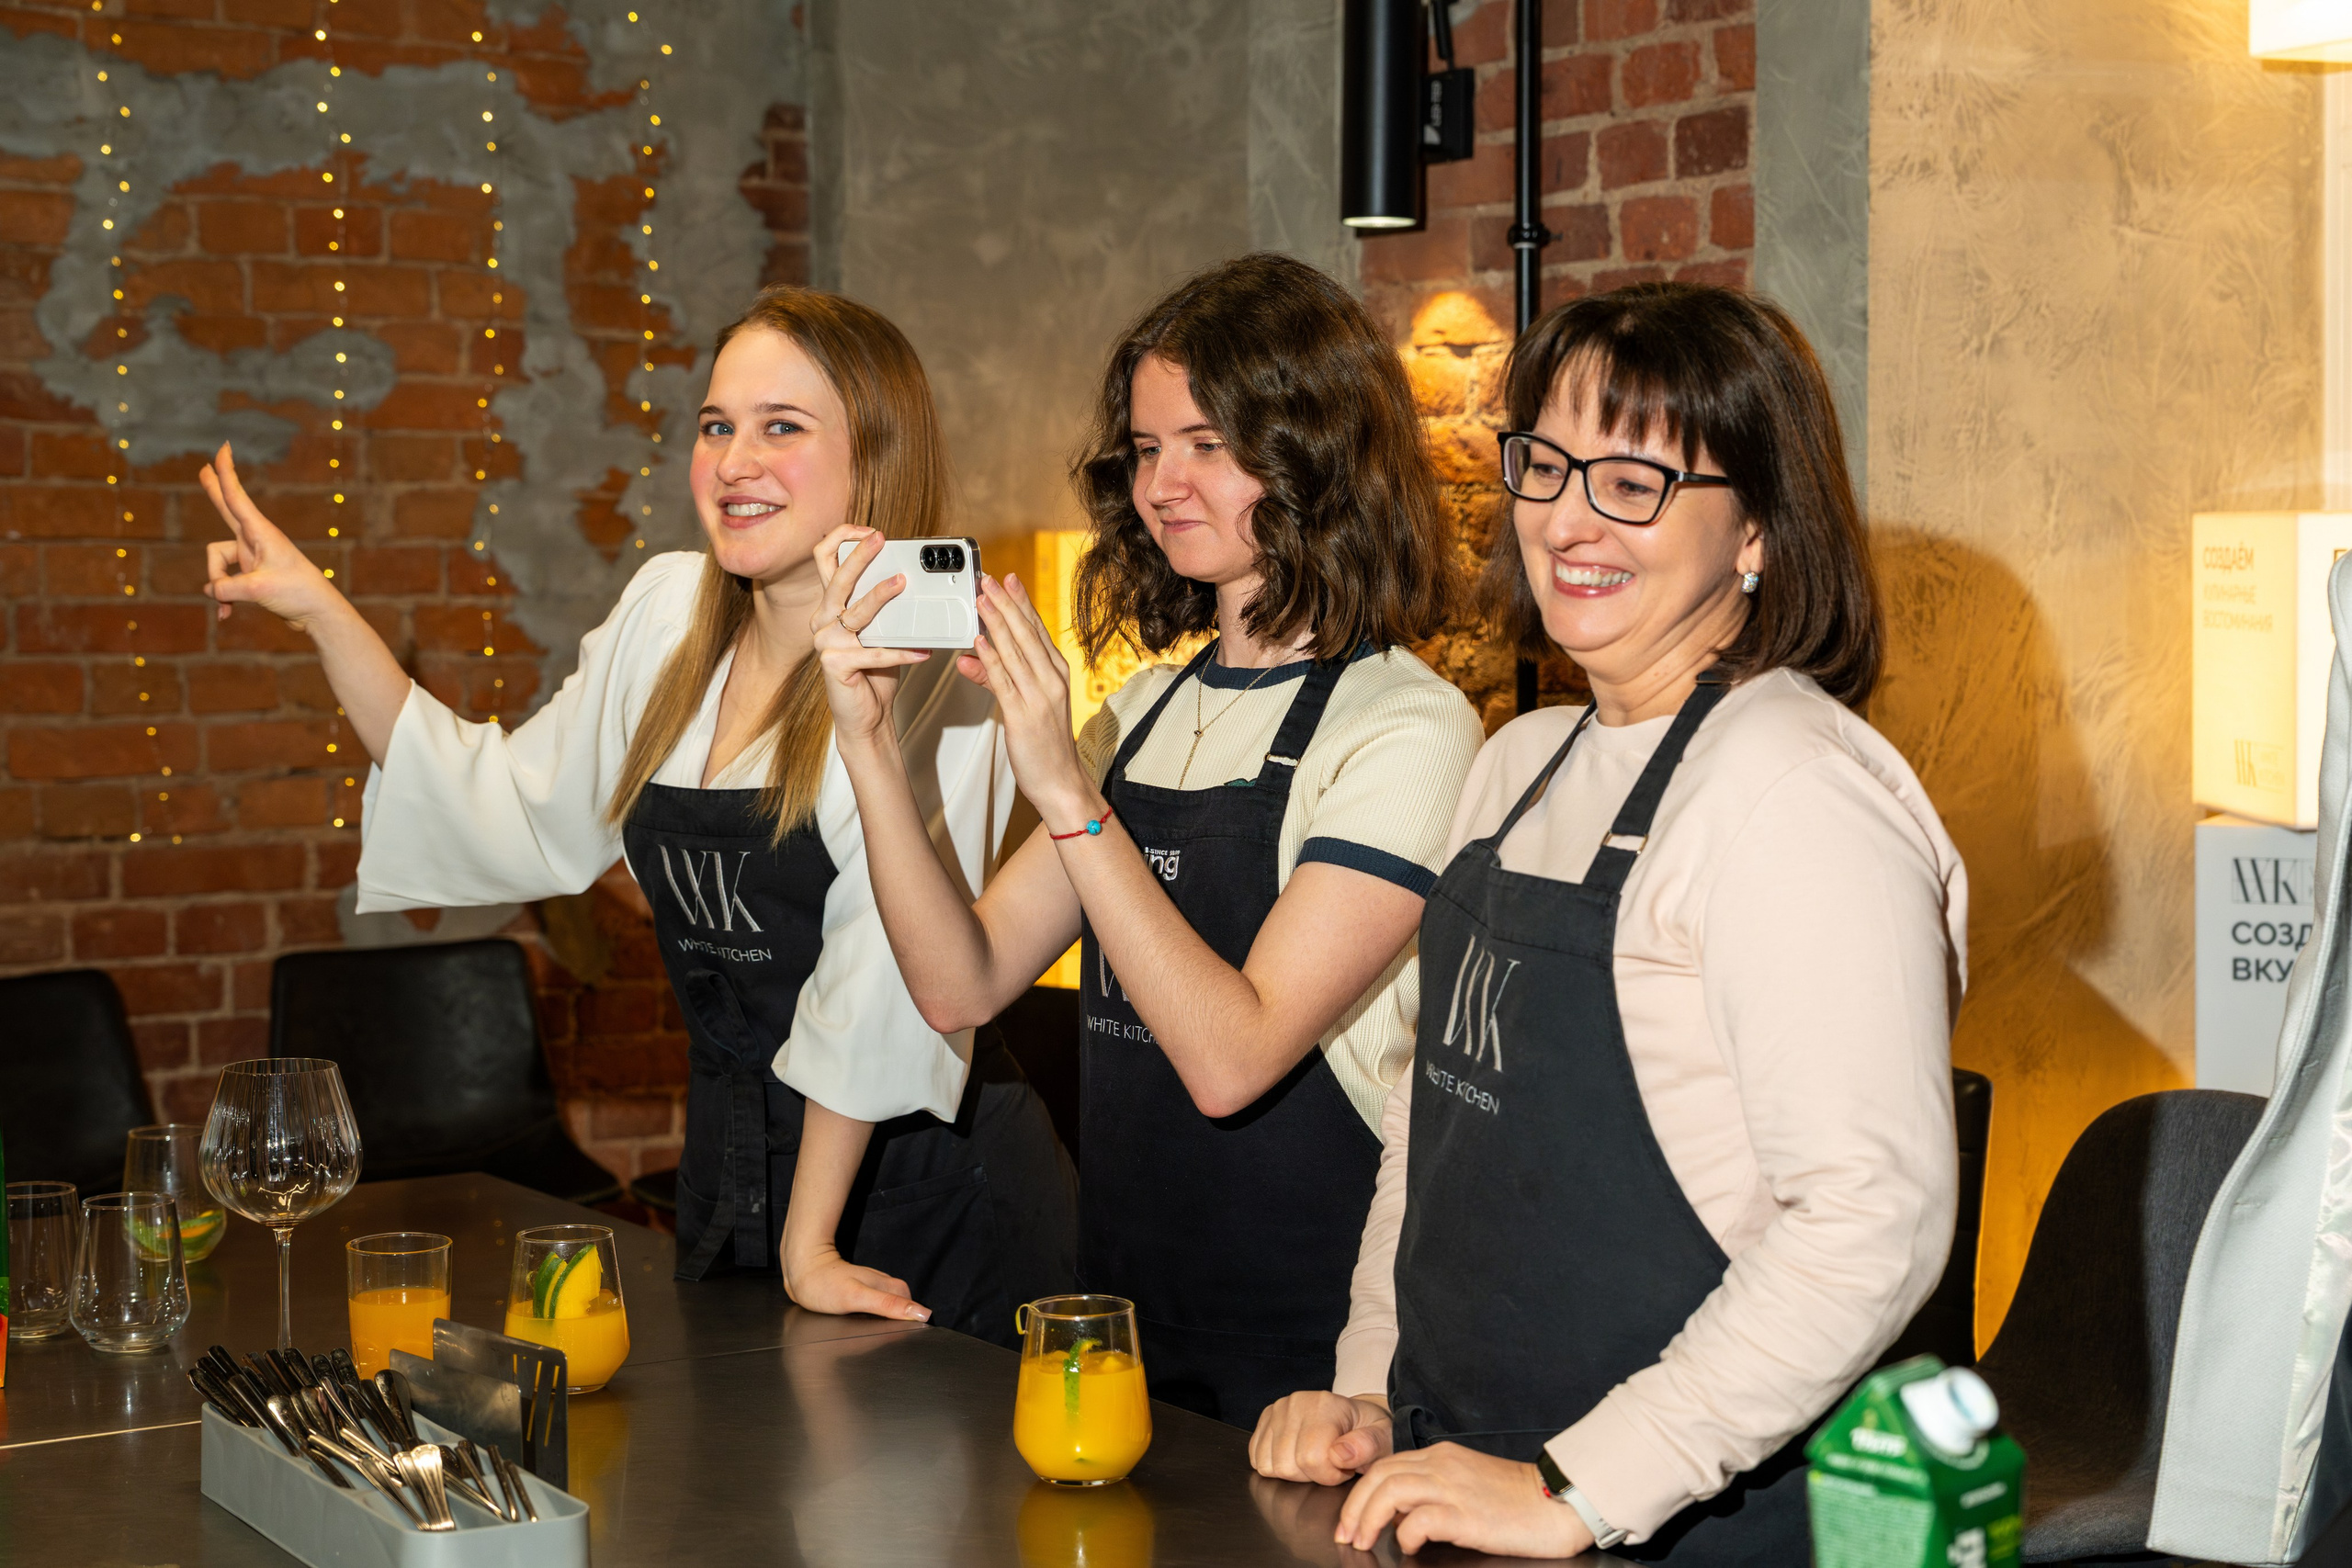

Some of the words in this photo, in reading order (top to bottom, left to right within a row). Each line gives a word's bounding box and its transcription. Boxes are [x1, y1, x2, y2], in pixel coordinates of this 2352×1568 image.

[658, 844, 764, 931] WK
[678, 938, 717, 954] WHITE
[2232, 921, 2314, 951] СОЗД
[2233, 957, 2295, 982] ВКУ
[1087, 1015, 1120, 1037] WHITE
